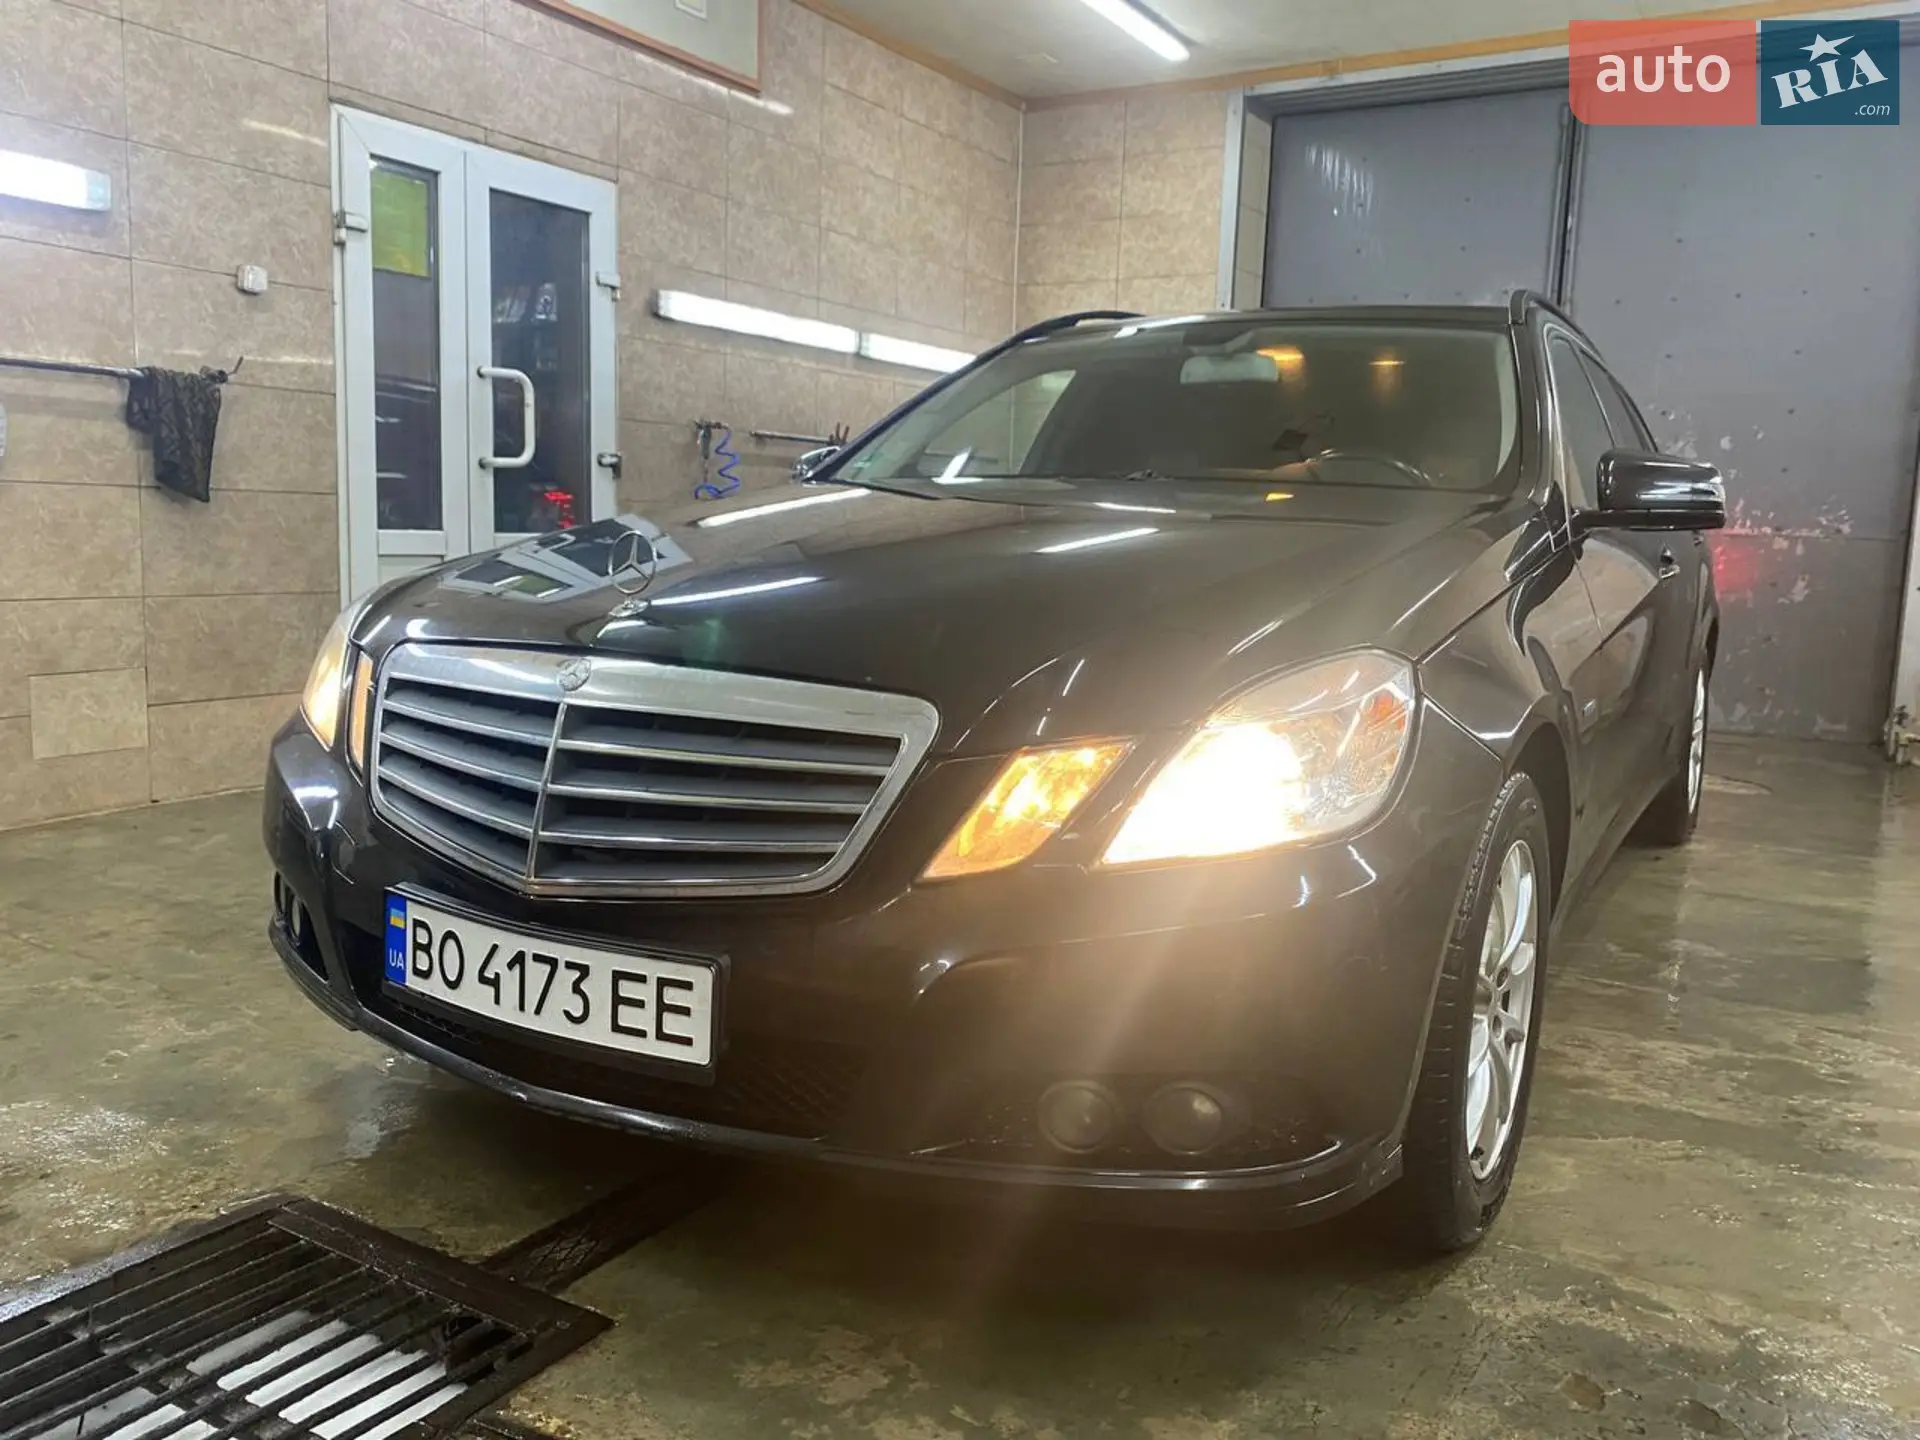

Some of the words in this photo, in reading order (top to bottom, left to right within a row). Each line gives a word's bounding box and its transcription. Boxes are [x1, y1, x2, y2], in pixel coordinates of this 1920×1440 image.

[389, 948, 405, 970] UA
[411, 917, 464, 990] BO
[477, 943, 590, 1024] 4173
[611, 969, 694, 1047] EE
